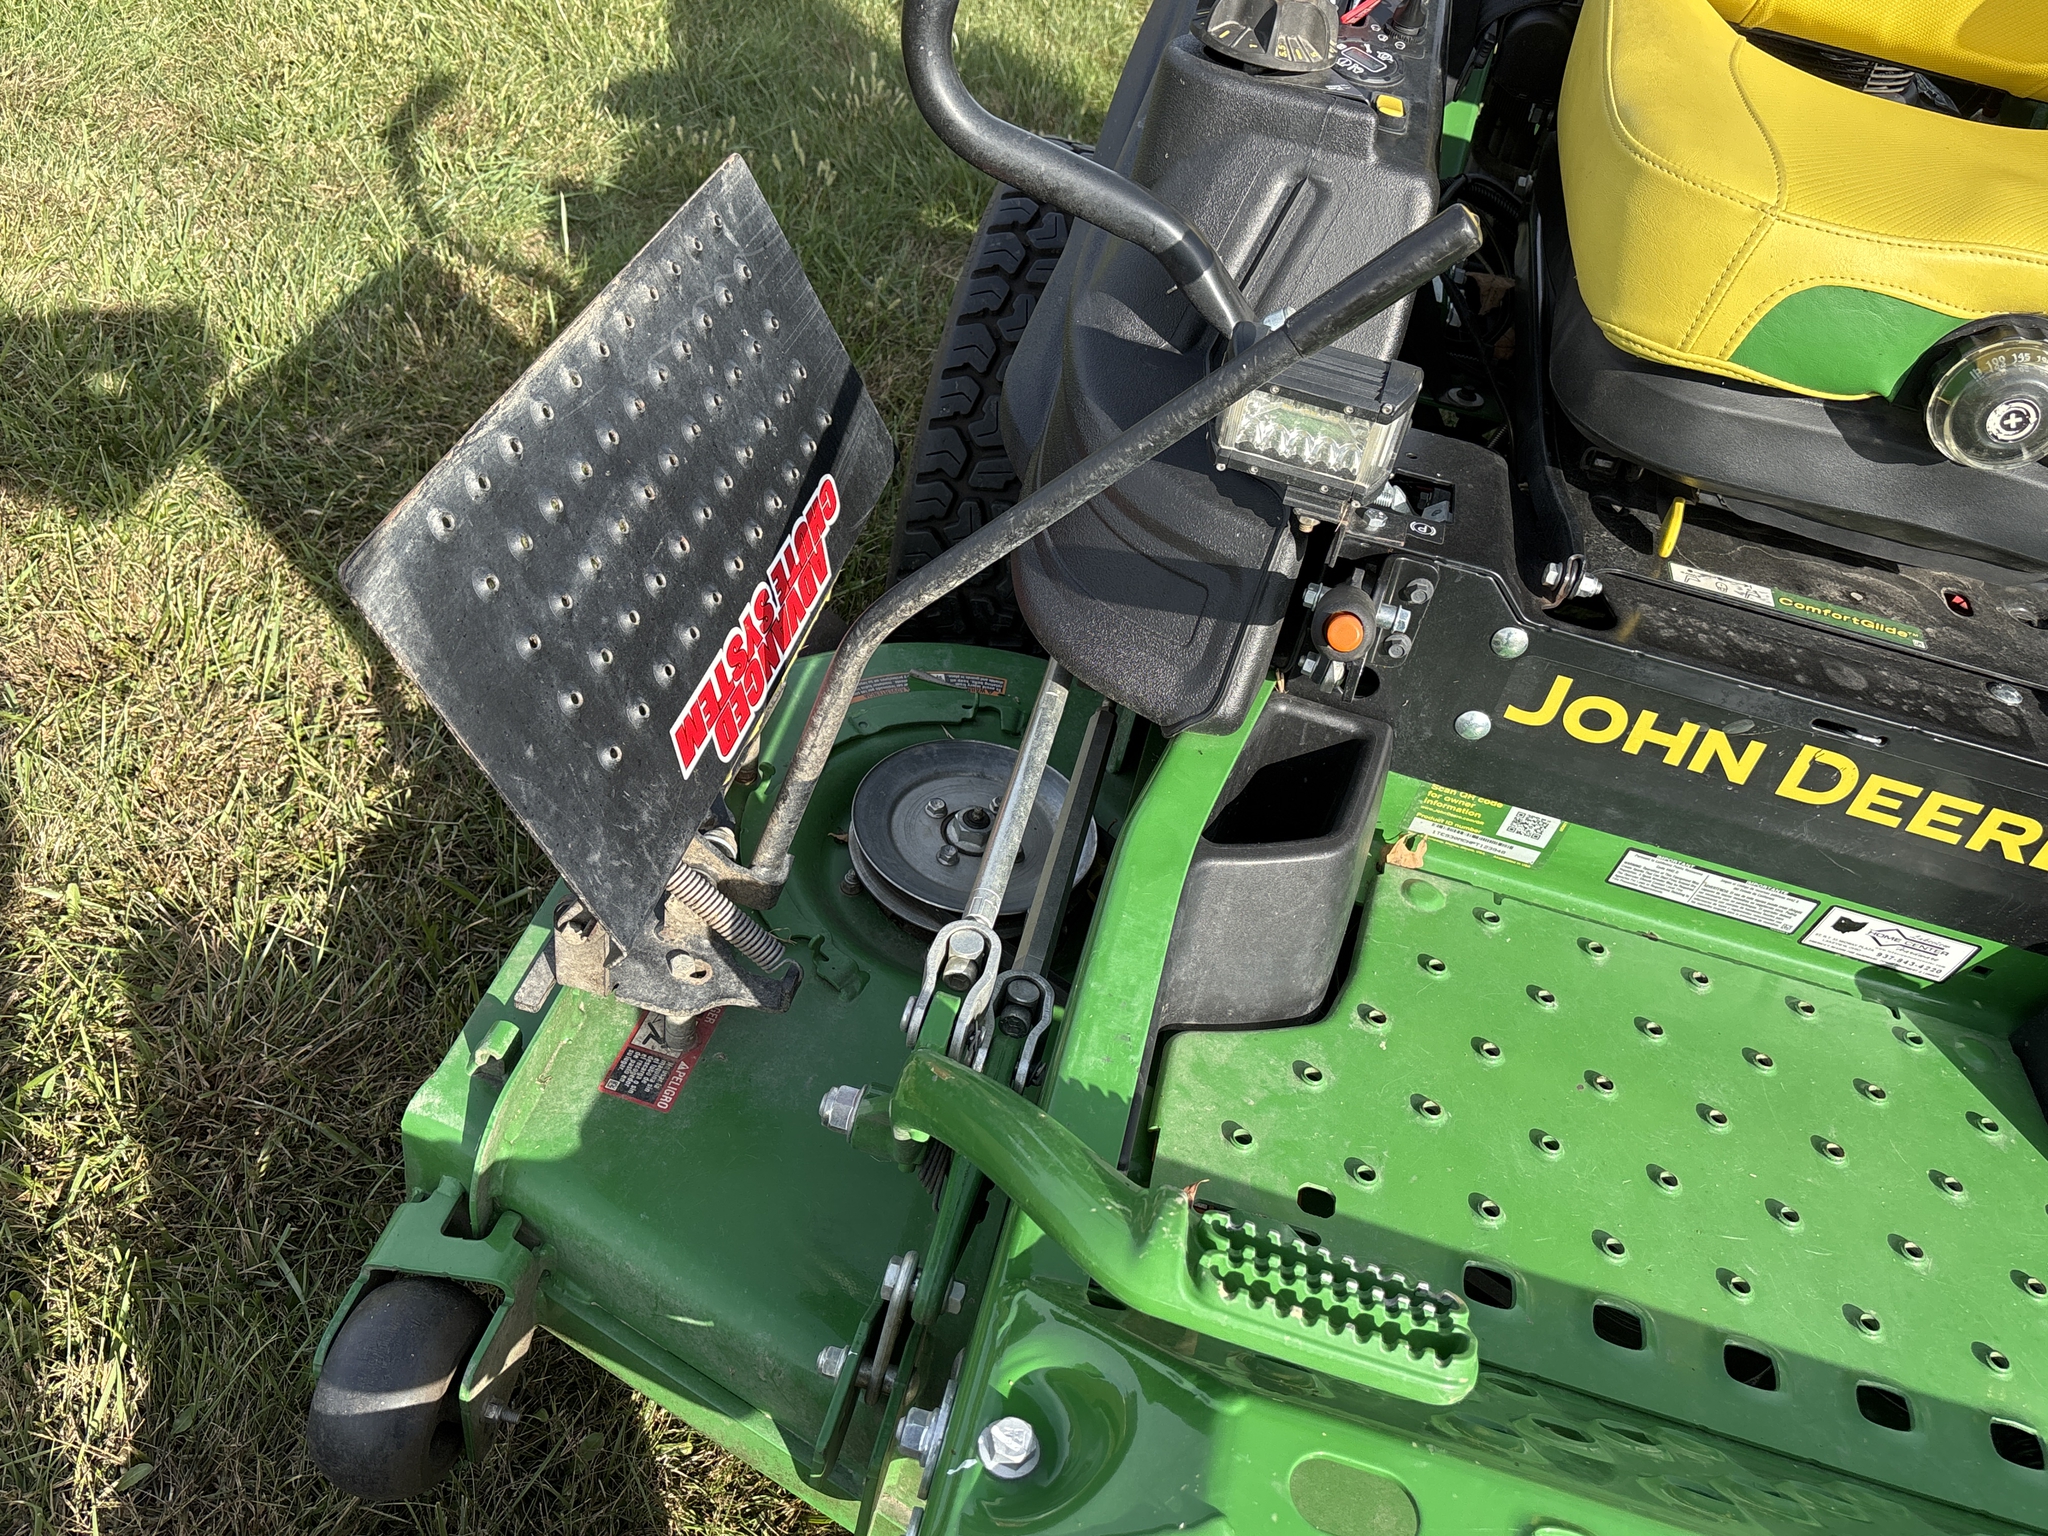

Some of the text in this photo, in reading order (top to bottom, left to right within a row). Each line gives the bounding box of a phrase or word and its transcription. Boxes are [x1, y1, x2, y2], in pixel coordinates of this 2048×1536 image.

[675, 479, 838, 769] CHUTE SYSTEM
[714, 537, 828, 757] ADVANCED
[1503, 675, 2048, 872] JOHN DEER
[1422, 796, 1482, 818] information
[1426, 789, 1476, 809] for owner
[1429, 783, 1457, 795] Scan
[1476, 796, 1504, 808] code
[1866, 930, 1902, 943] HOME
[1902, 940, 1950, 956] CENTER
[657, 1069, 686, 1109] PELIGRO
